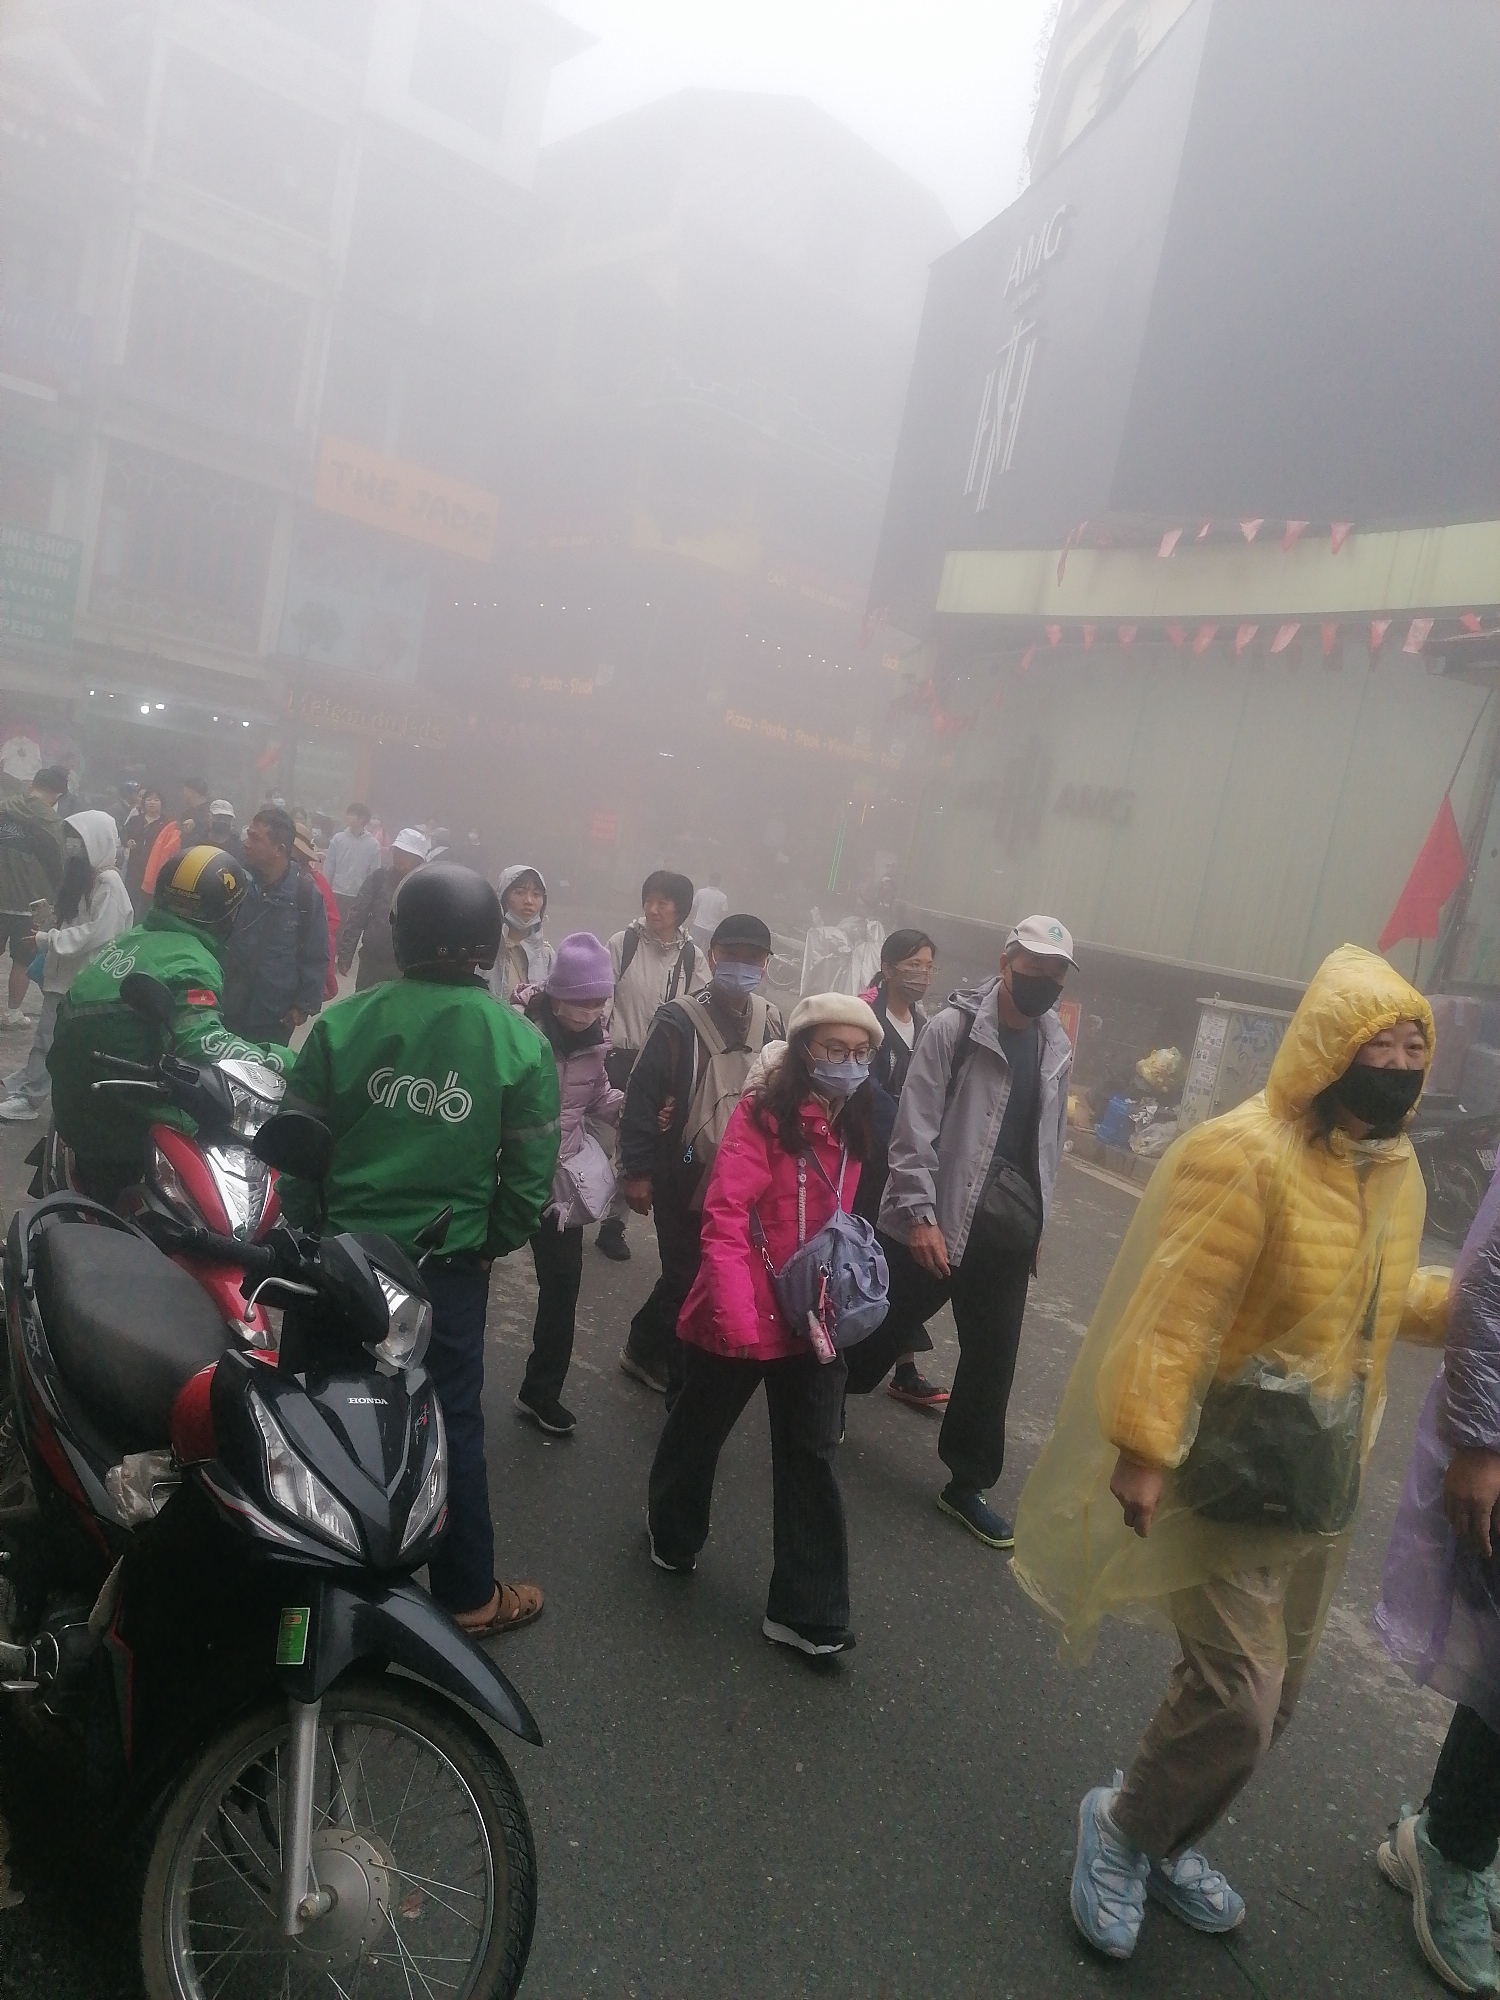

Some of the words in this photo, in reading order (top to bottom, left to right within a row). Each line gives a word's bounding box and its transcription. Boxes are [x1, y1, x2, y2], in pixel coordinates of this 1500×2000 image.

[1002, 204, 1067, 300] AMG
[329, 459, 399, 508] THE
[408, 489, 491, 540] JADE
[5, 550, 70, 580] STATION
[34, 534, 77, 560] SHOP
[725, 709, 753, 730] Pizza
[759, 719, 788, 740] Pasta
[795, 729, 820, 749] Steak
[1052, 783, 1136, 828] AMG
[347, 1397, 389, 1405] HONDA
